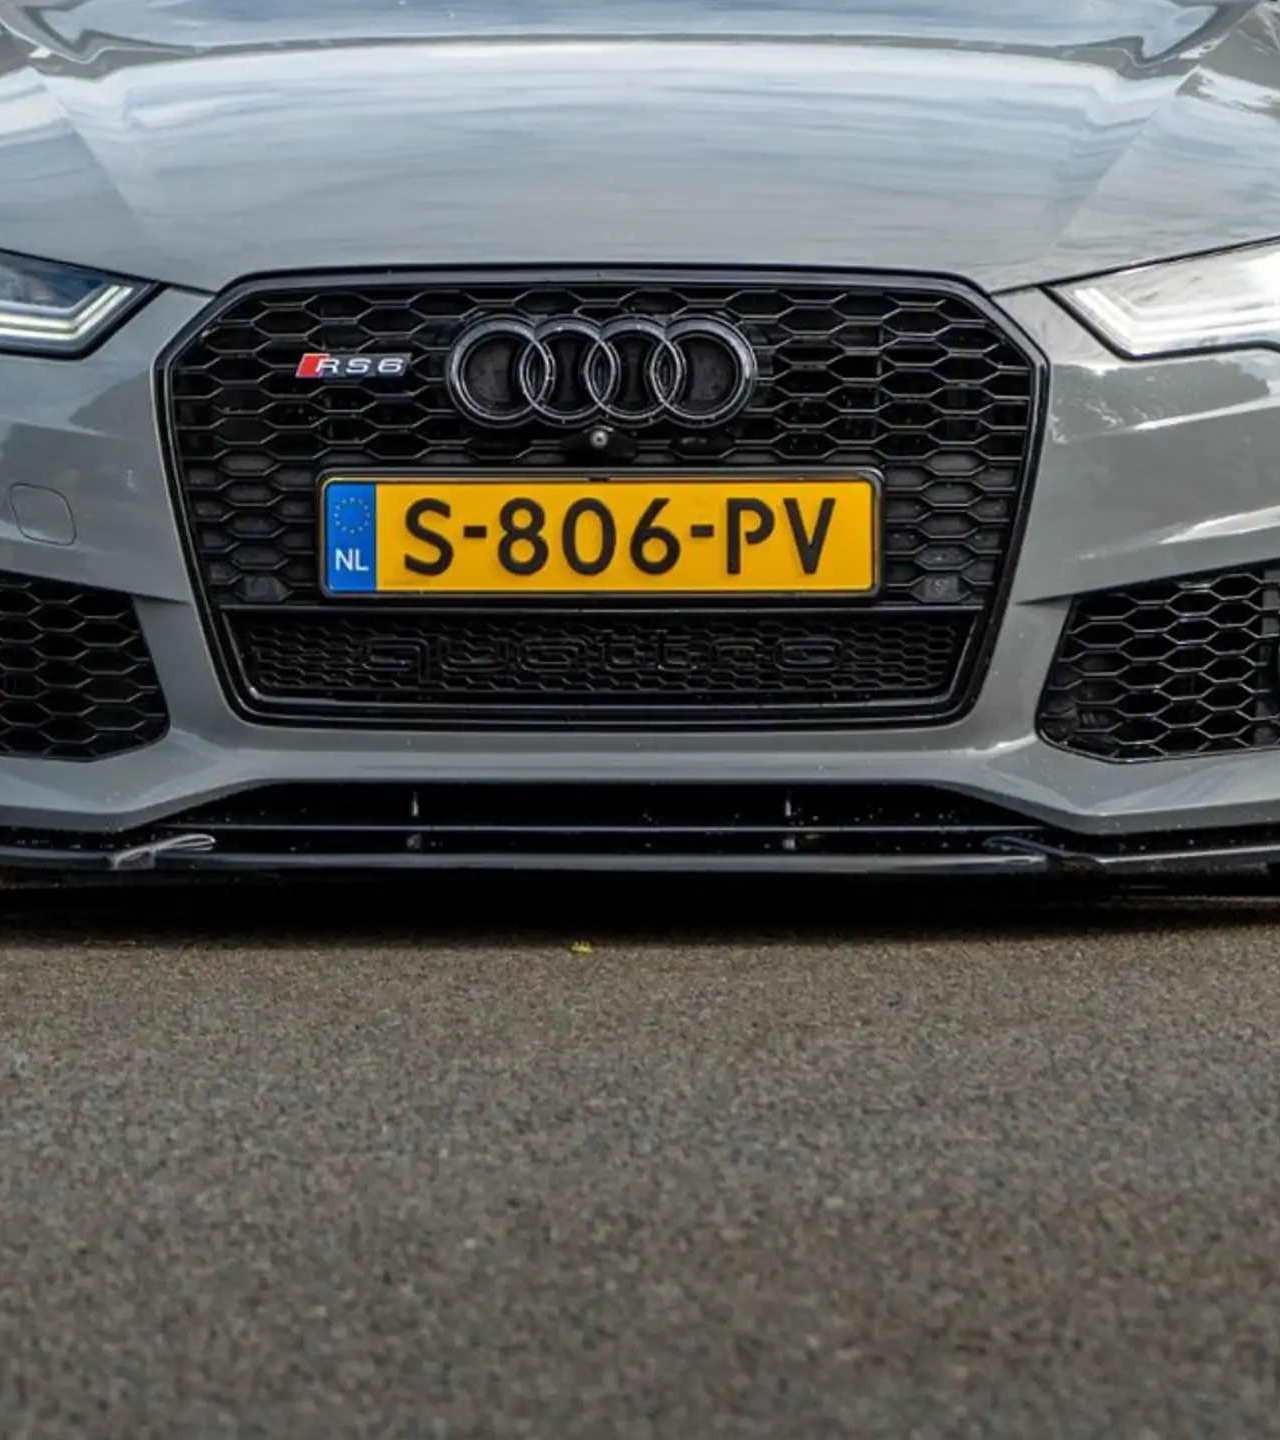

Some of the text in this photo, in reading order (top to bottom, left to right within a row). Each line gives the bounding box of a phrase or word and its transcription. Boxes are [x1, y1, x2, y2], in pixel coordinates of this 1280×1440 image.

[315, 356, 403, 375] RS6
[402, 496, 836, 576] S-806-PV
[335, 549, 369, 572] NL
